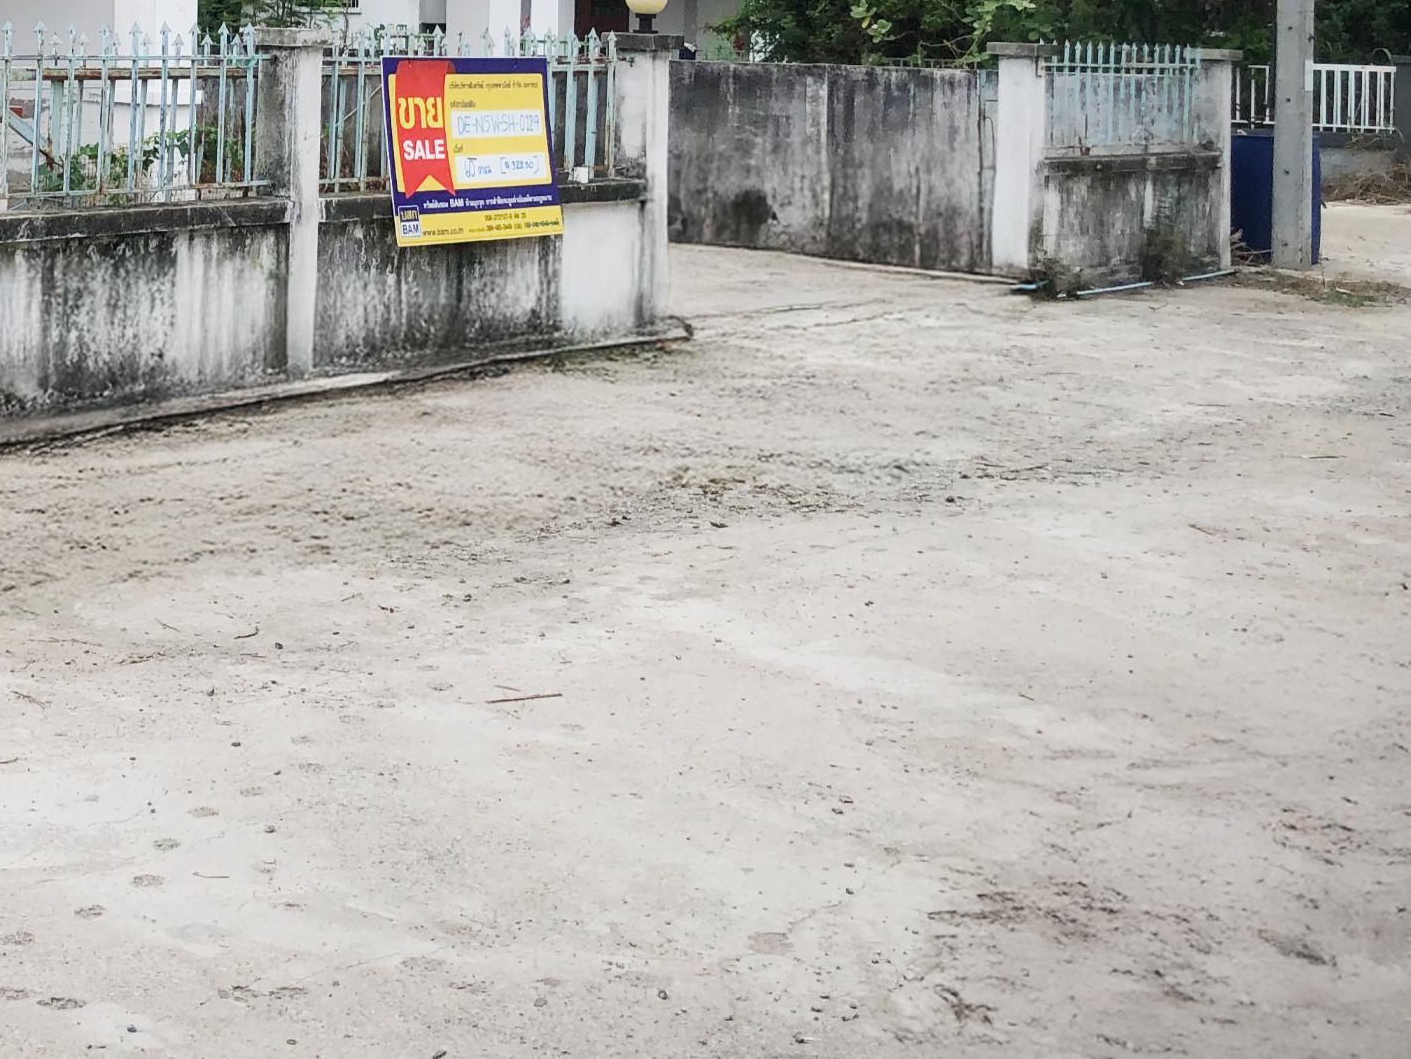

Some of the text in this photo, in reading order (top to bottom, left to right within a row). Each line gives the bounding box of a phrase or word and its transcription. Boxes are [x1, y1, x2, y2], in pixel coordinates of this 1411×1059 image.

[399, 97, 443, 129] ขาย
[403, 139, 446, 161] SALE
[449, 198, 464, 208] BAM
[402, 224, 419, 235] BAM
